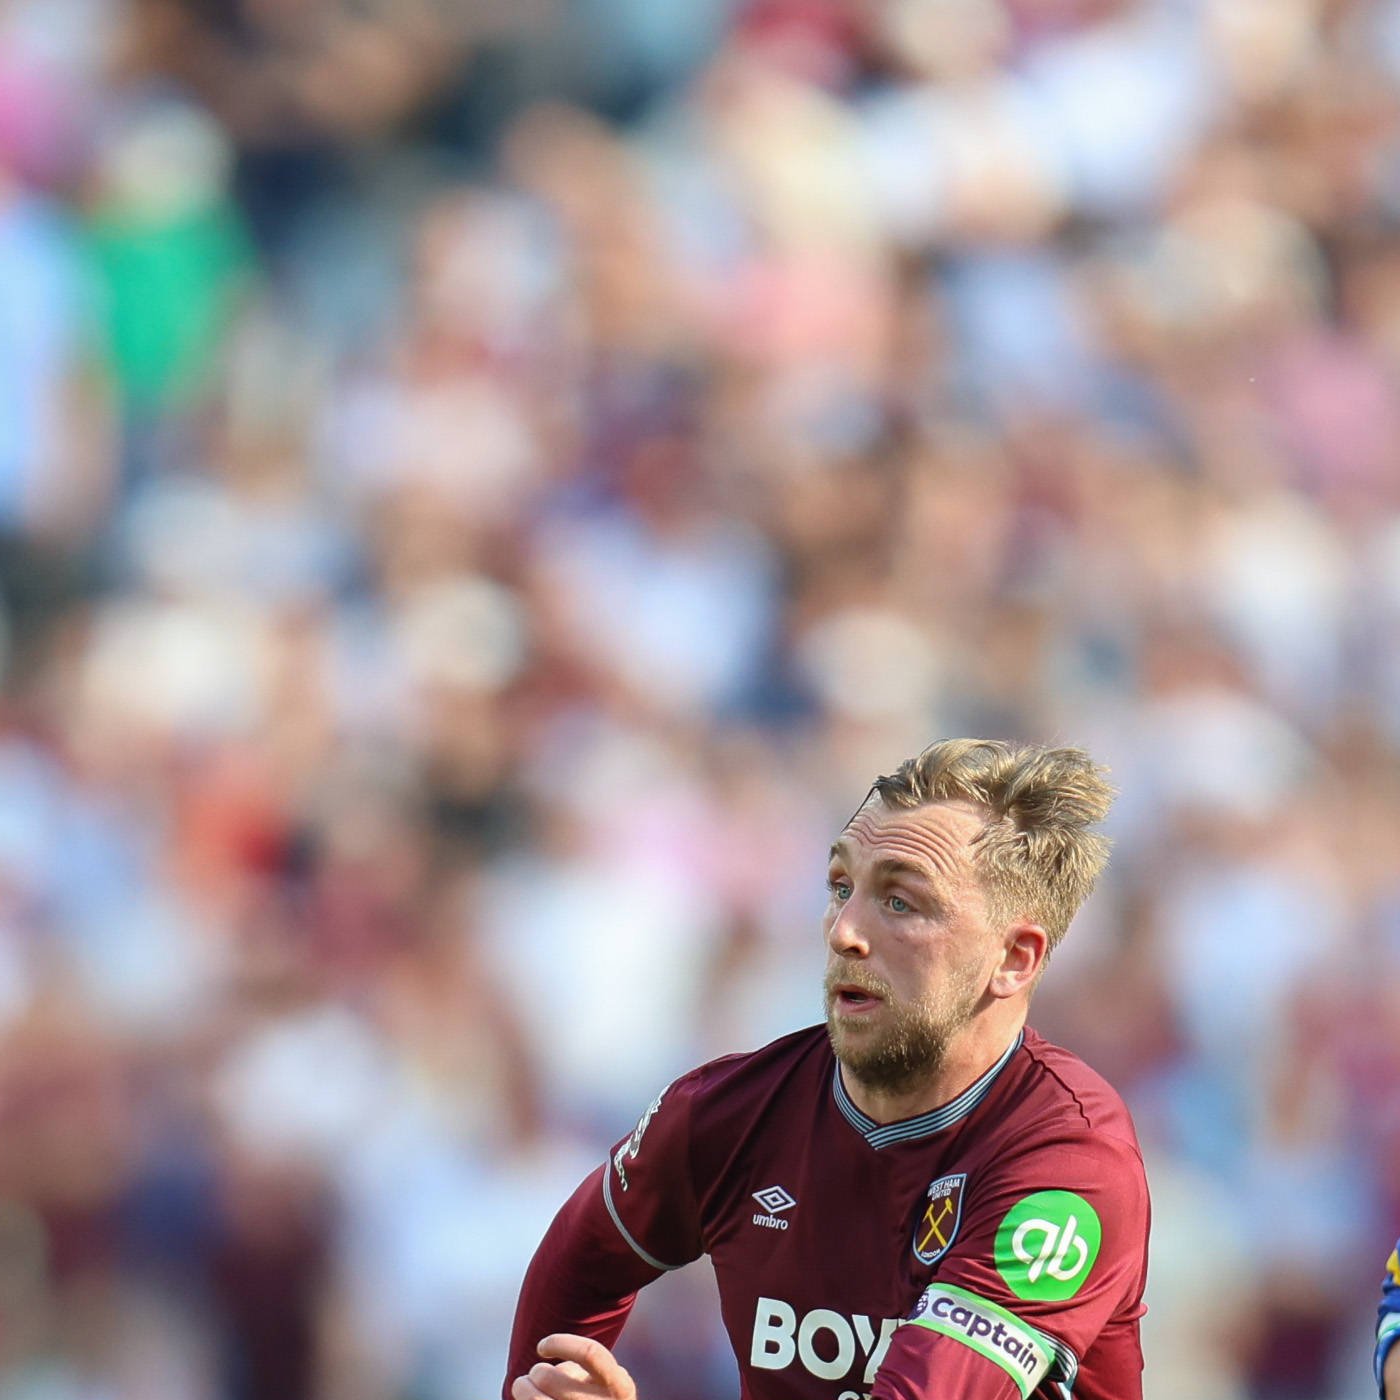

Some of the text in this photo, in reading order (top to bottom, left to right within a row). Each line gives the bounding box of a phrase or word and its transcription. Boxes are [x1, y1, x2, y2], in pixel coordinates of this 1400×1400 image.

[944, 1179, 961, 1189] HAM
[752, 1214, 789, 1230] umbro
[751, 1297, 907, 1384] BOY
